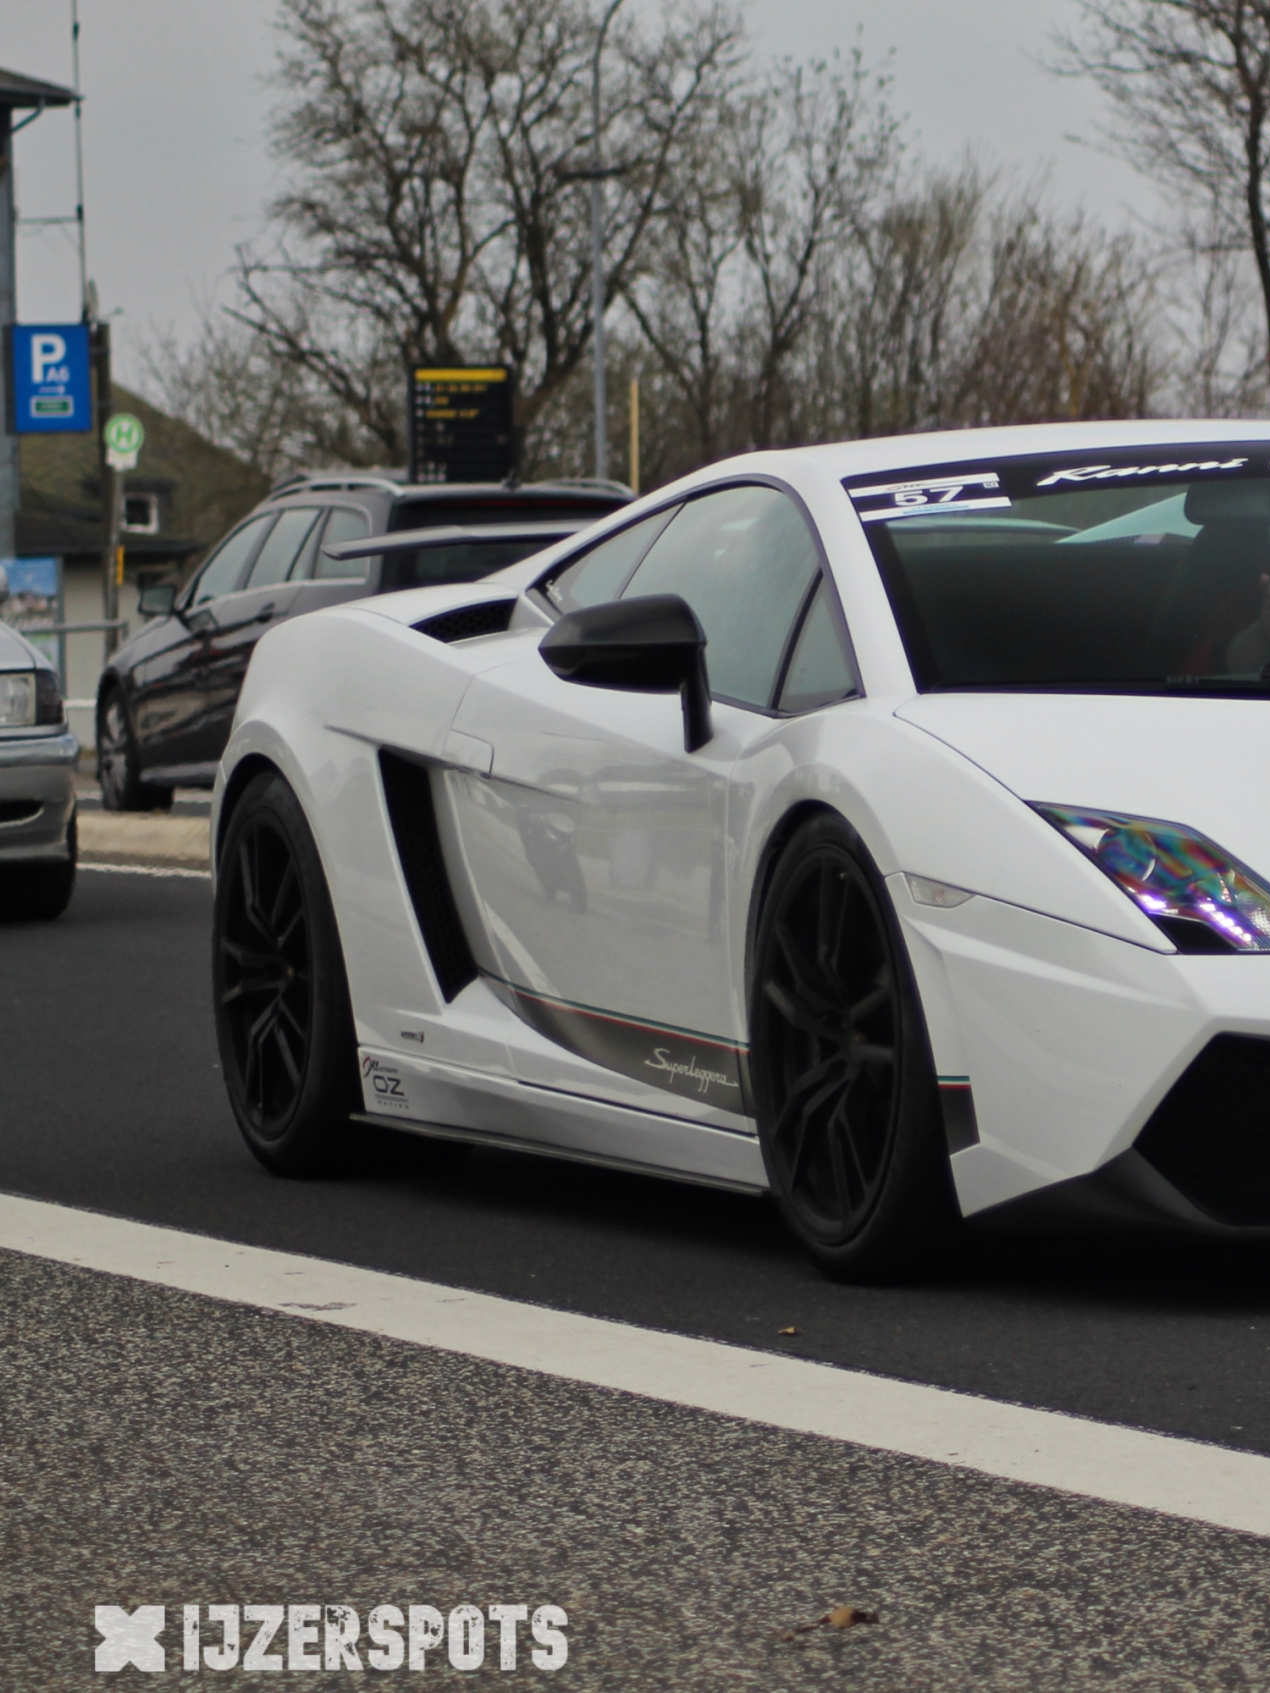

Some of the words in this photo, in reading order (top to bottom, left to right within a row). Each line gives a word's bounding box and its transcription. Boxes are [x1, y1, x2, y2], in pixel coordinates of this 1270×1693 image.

[31, 334, 67, 384] P
[115, 424, 134, 445] H
[894, 485, 964, 507] 57
[644, 1047, 739, 1093] Superleggera
[373, 1074, 405, 1097] OZ
